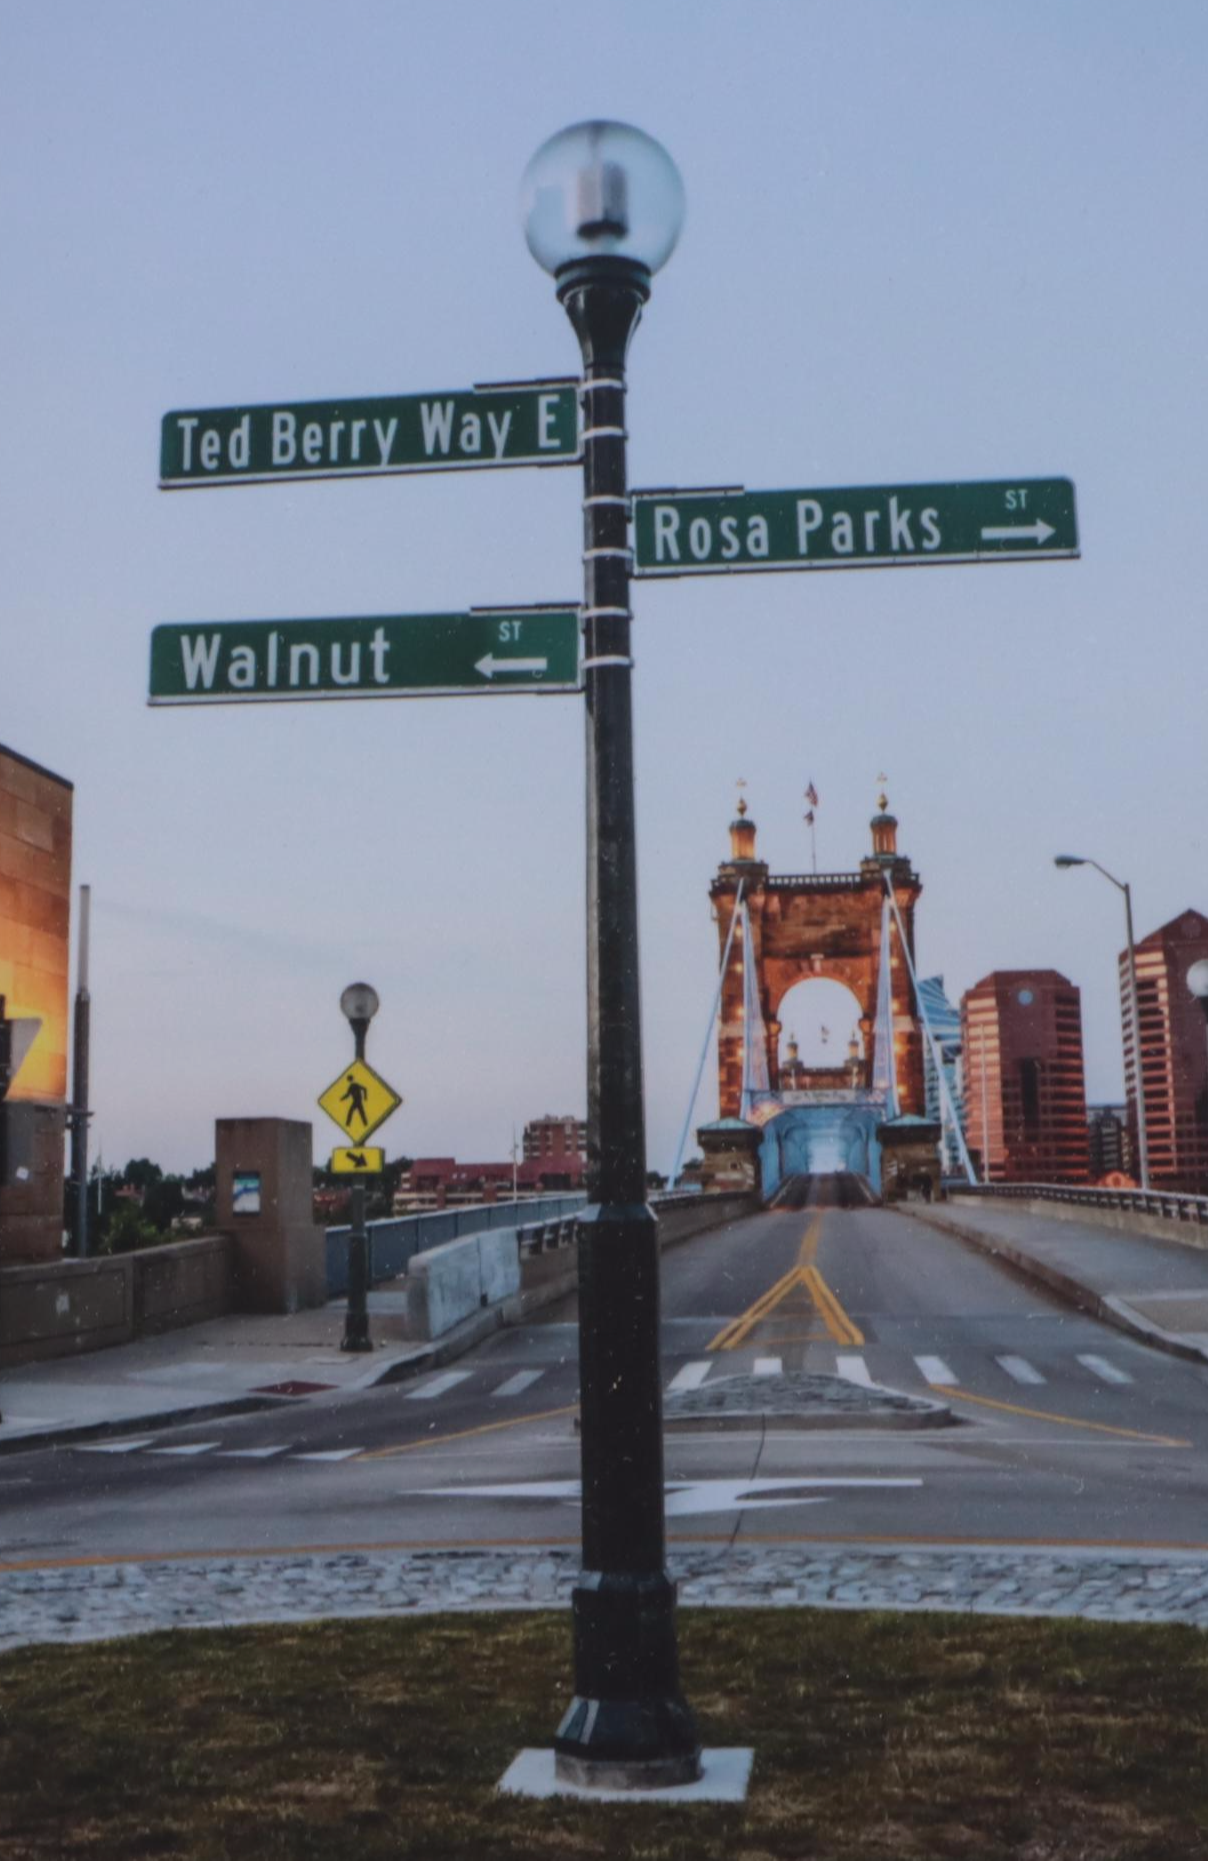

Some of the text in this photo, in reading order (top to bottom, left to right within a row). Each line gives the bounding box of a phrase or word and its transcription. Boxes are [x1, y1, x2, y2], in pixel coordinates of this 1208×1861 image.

[178, 394, 560, 471] Ted Berry Way E
[653, 489, 1027, 562] Rosa Parks ST
[181, 621, 521, 690] Walnut ST
